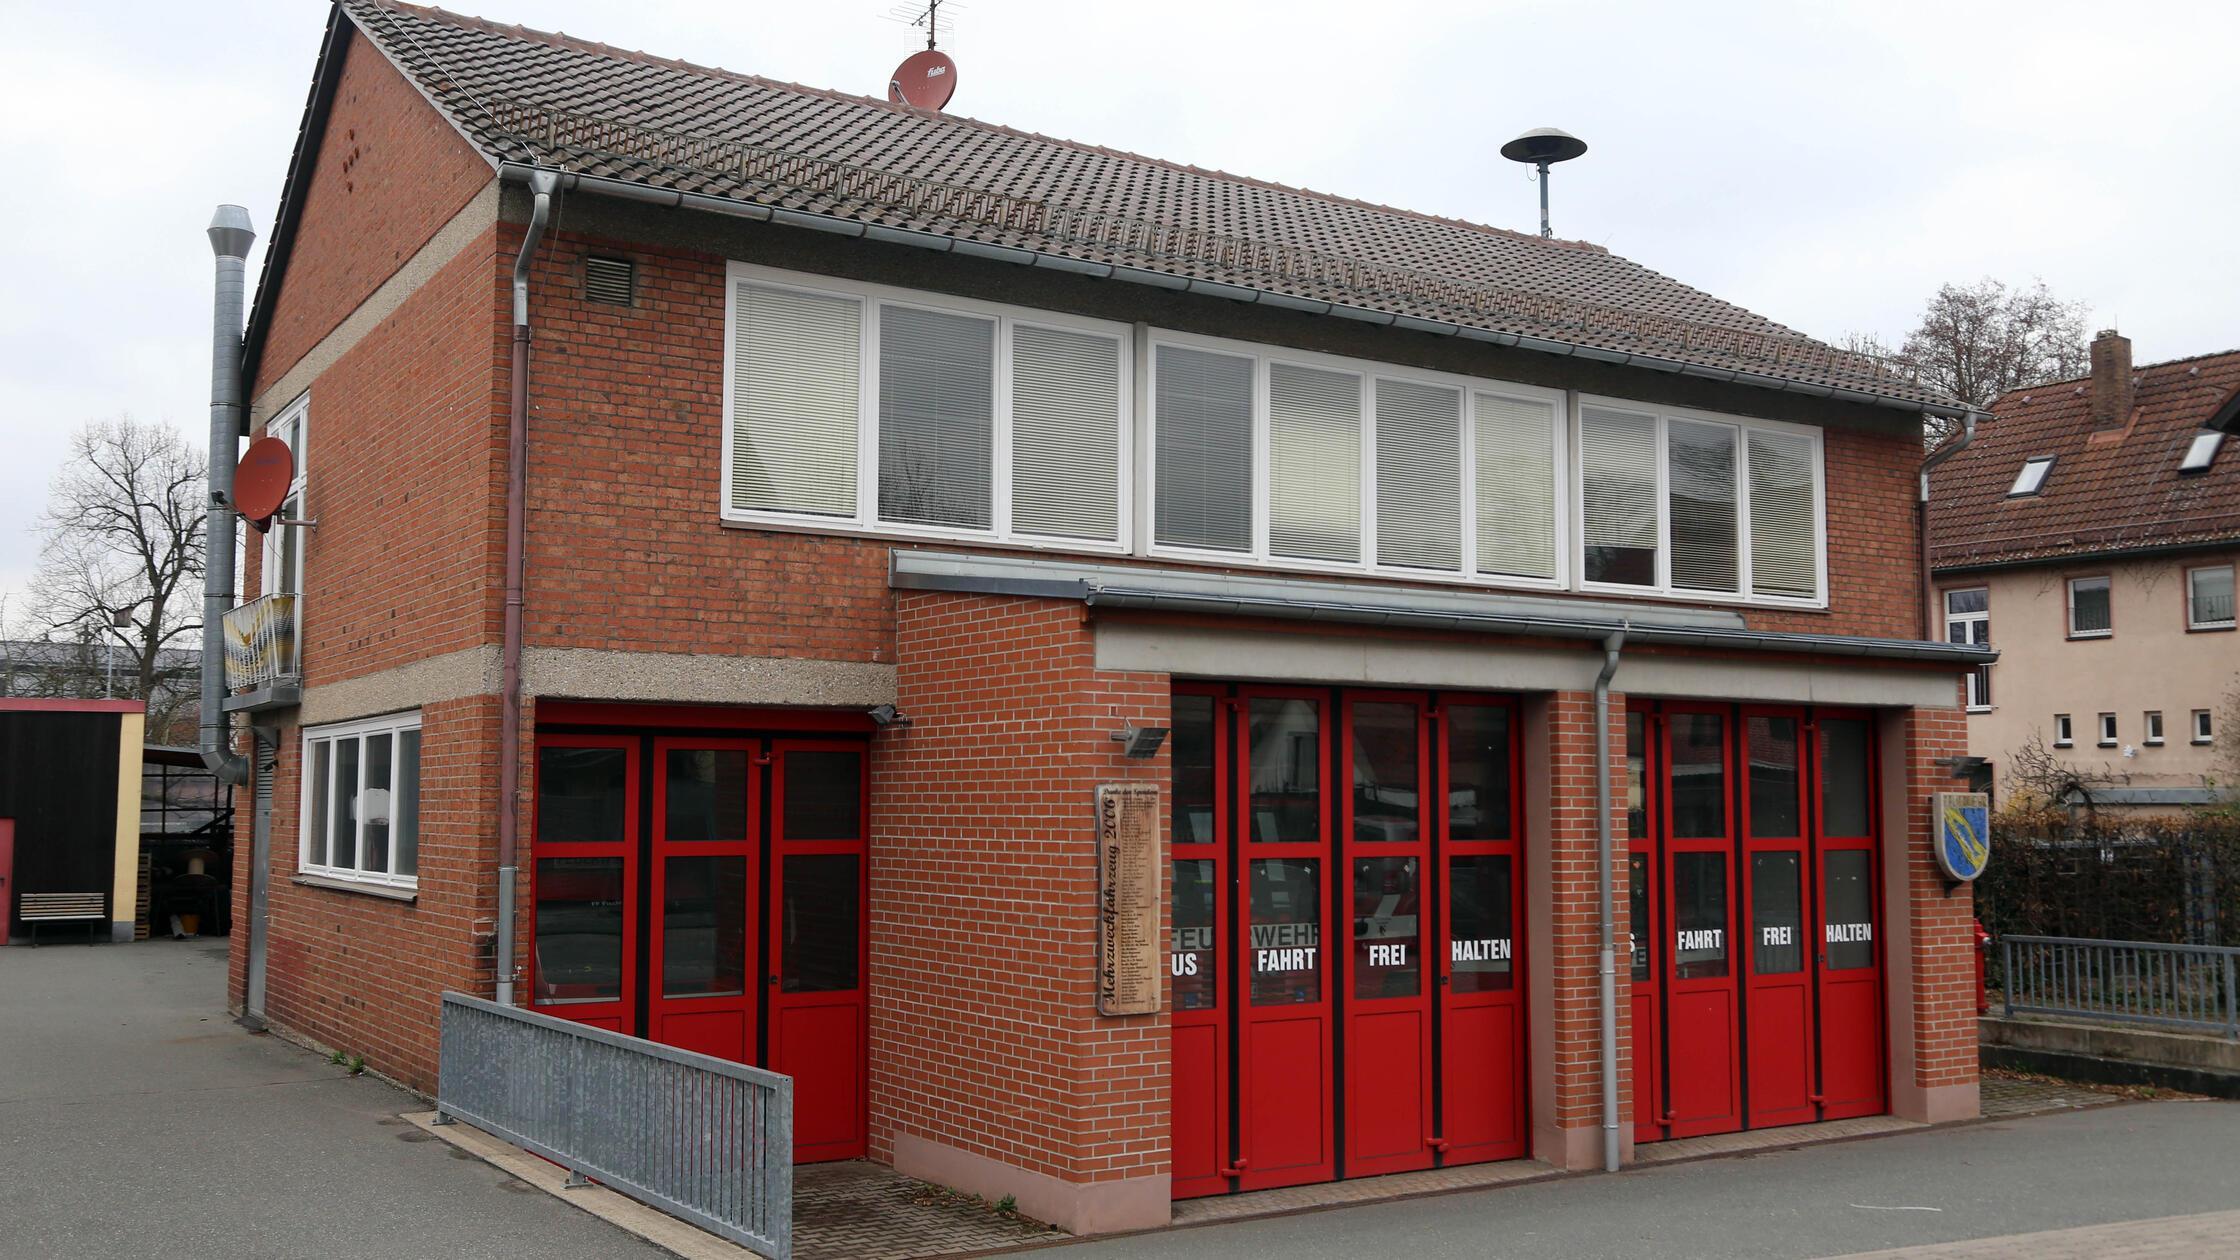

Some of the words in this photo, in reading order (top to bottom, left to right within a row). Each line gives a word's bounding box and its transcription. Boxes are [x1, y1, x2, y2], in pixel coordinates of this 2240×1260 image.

[1103, 797, 1117, 840] 2006
[1103, 845, 1121, 1005] Mehrzweckfahrzeug
[1677, 928, 1722, 951] FAHRT
[1762, 926, 1792, 946] FREI
[1825, 923, 1872, 943] HALTEN
[1257, 944, 1317, 972] FAHRT
[1369, 944, 1406, 967] FREI
[1451, 938, 1511, 962] HALTEN
